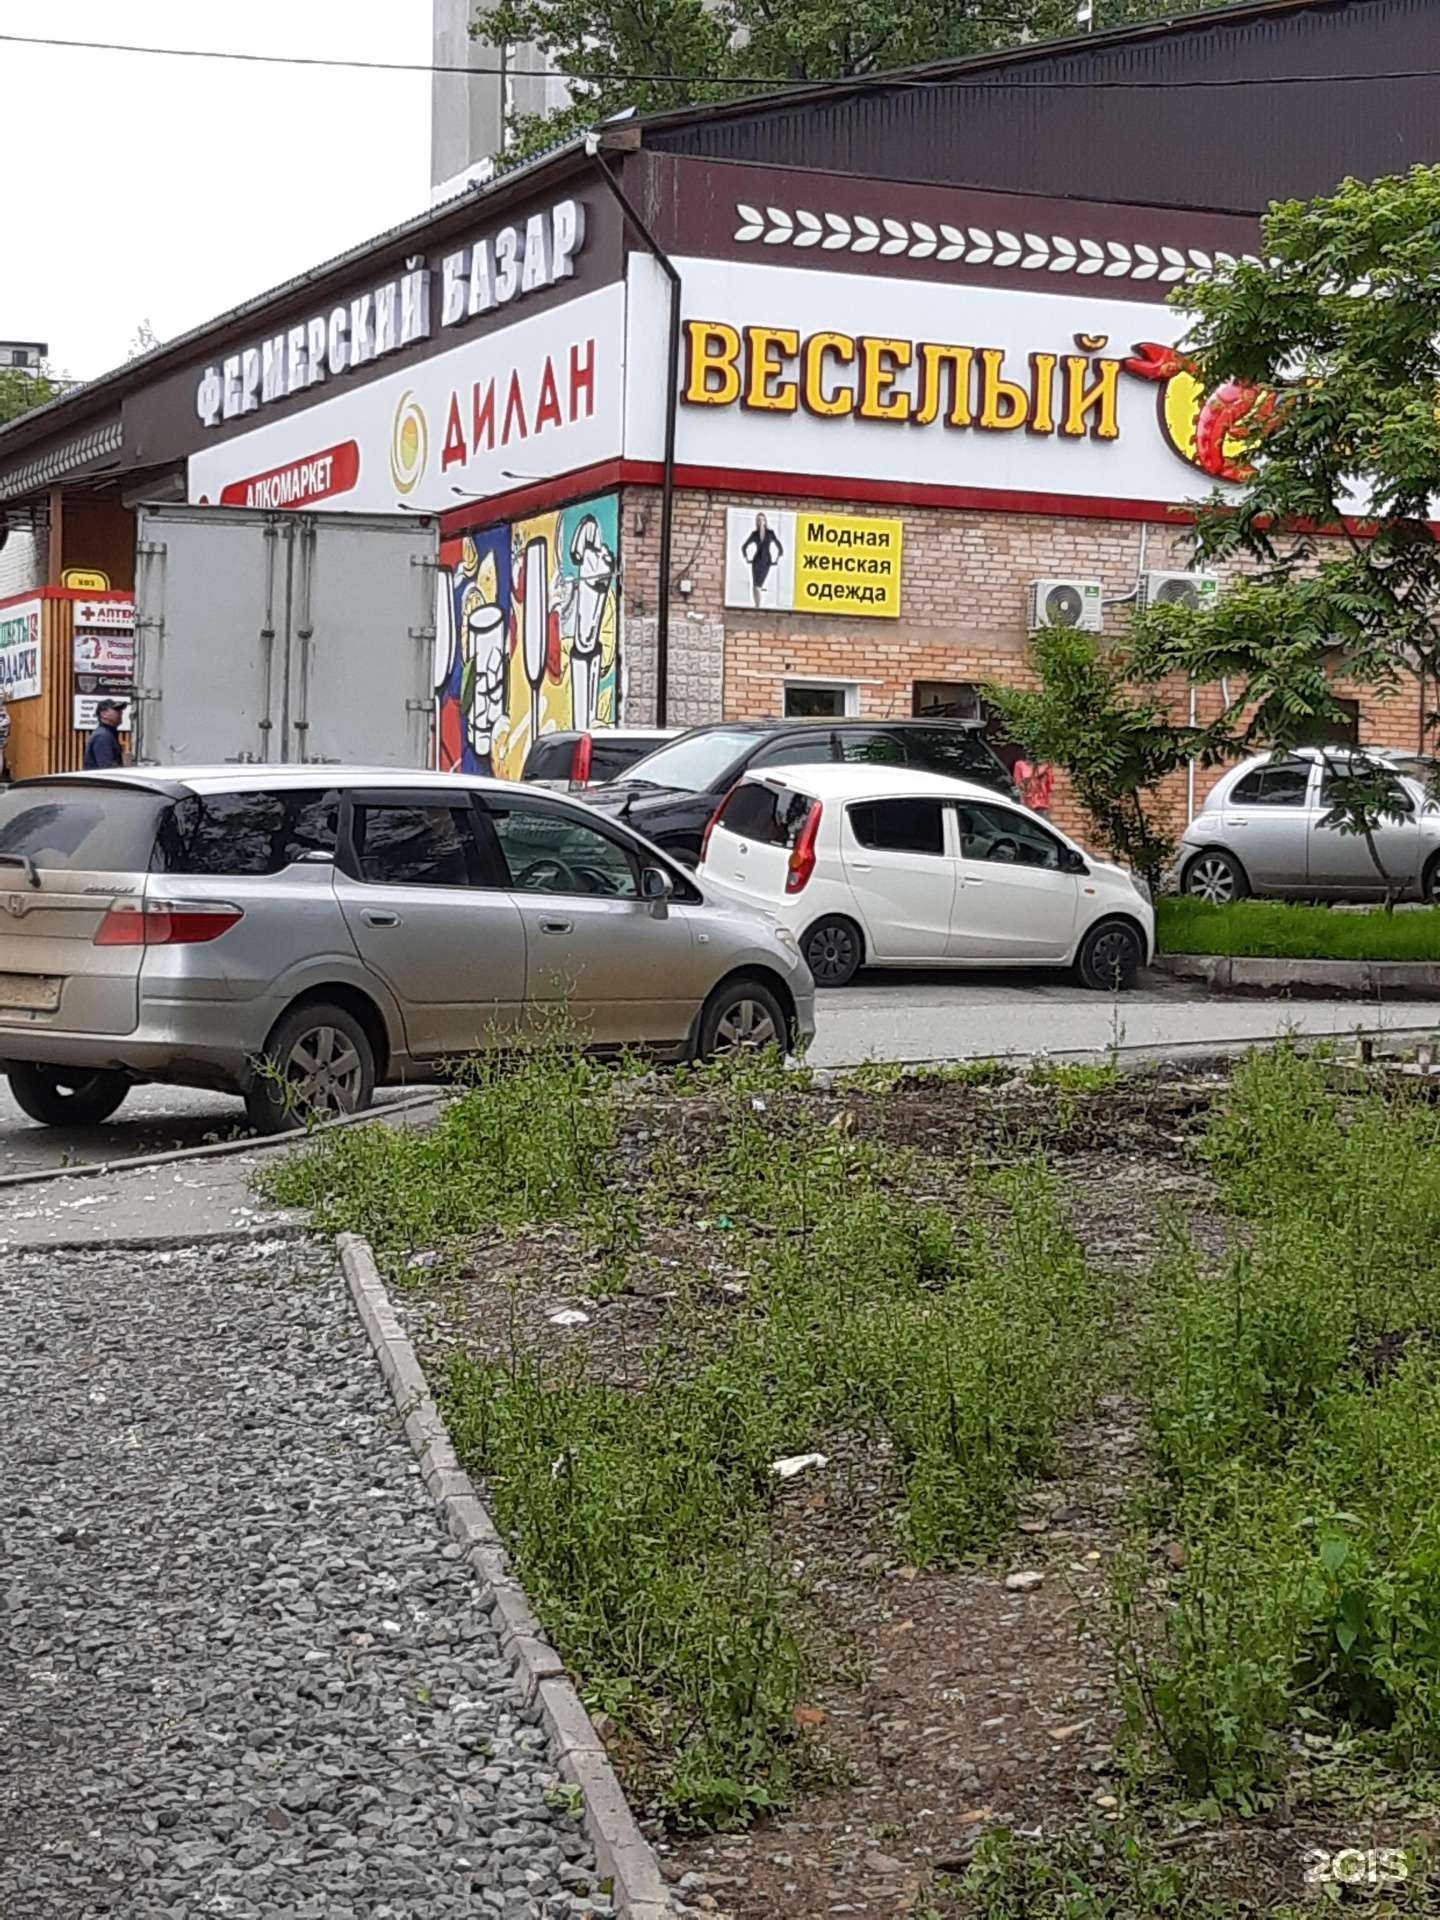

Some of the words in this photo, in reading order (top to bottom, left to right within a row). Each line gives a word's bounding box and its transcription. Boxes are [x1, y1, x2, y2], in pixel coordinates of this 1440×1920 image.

[197, 255, 430, 427] ФЕРМЕРСКИЙ
[441, 200, 584, 327] БАЗАР
[681, 319, 1121, 441] ВЕСЕЛЫЙ
[442, 338, 596, 473] ДИЛАН
[246, 456, 333, 508] АЛКОМАРКЕТ
[807, 523, 890, 547] Модная
[803, 555, 891, 575] женская
[806, 582, 886, 604] одежда
[97, 608, 135, 618] АПТЕК
[0, 649, 37, 685] ОДАРКИ
